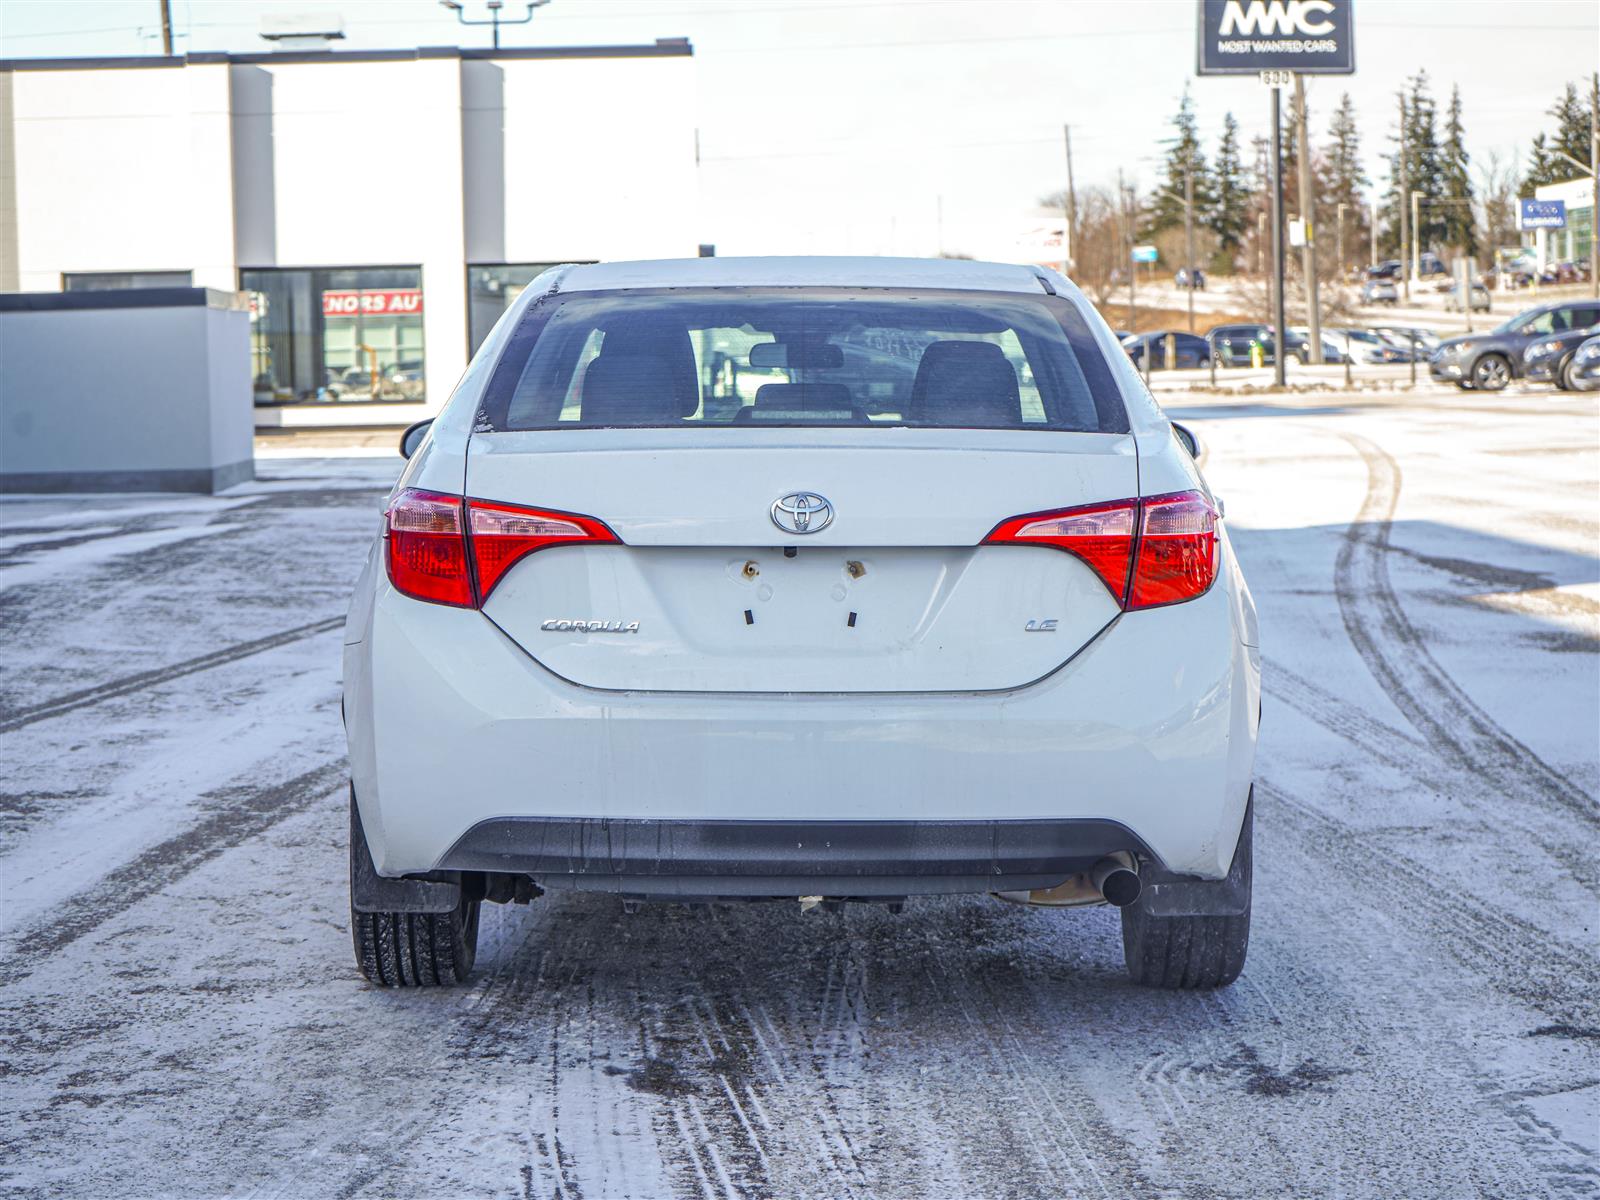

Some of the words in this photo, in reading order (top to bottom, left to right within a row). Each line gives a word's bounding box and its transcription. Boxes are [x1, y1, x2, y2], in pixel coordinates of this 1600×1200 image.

[1218, 0, 1337, 36] MWC
[1218, 40, 1251, 54] MOST
[1252, 40, 1303, 53] WANTED
[1303, 39, 1337, 53] CARS
[323, 294, 385, 313] NORS
[541, 618, 641, 634] COROLLA
[1024, 619, 1059, 632] LE
